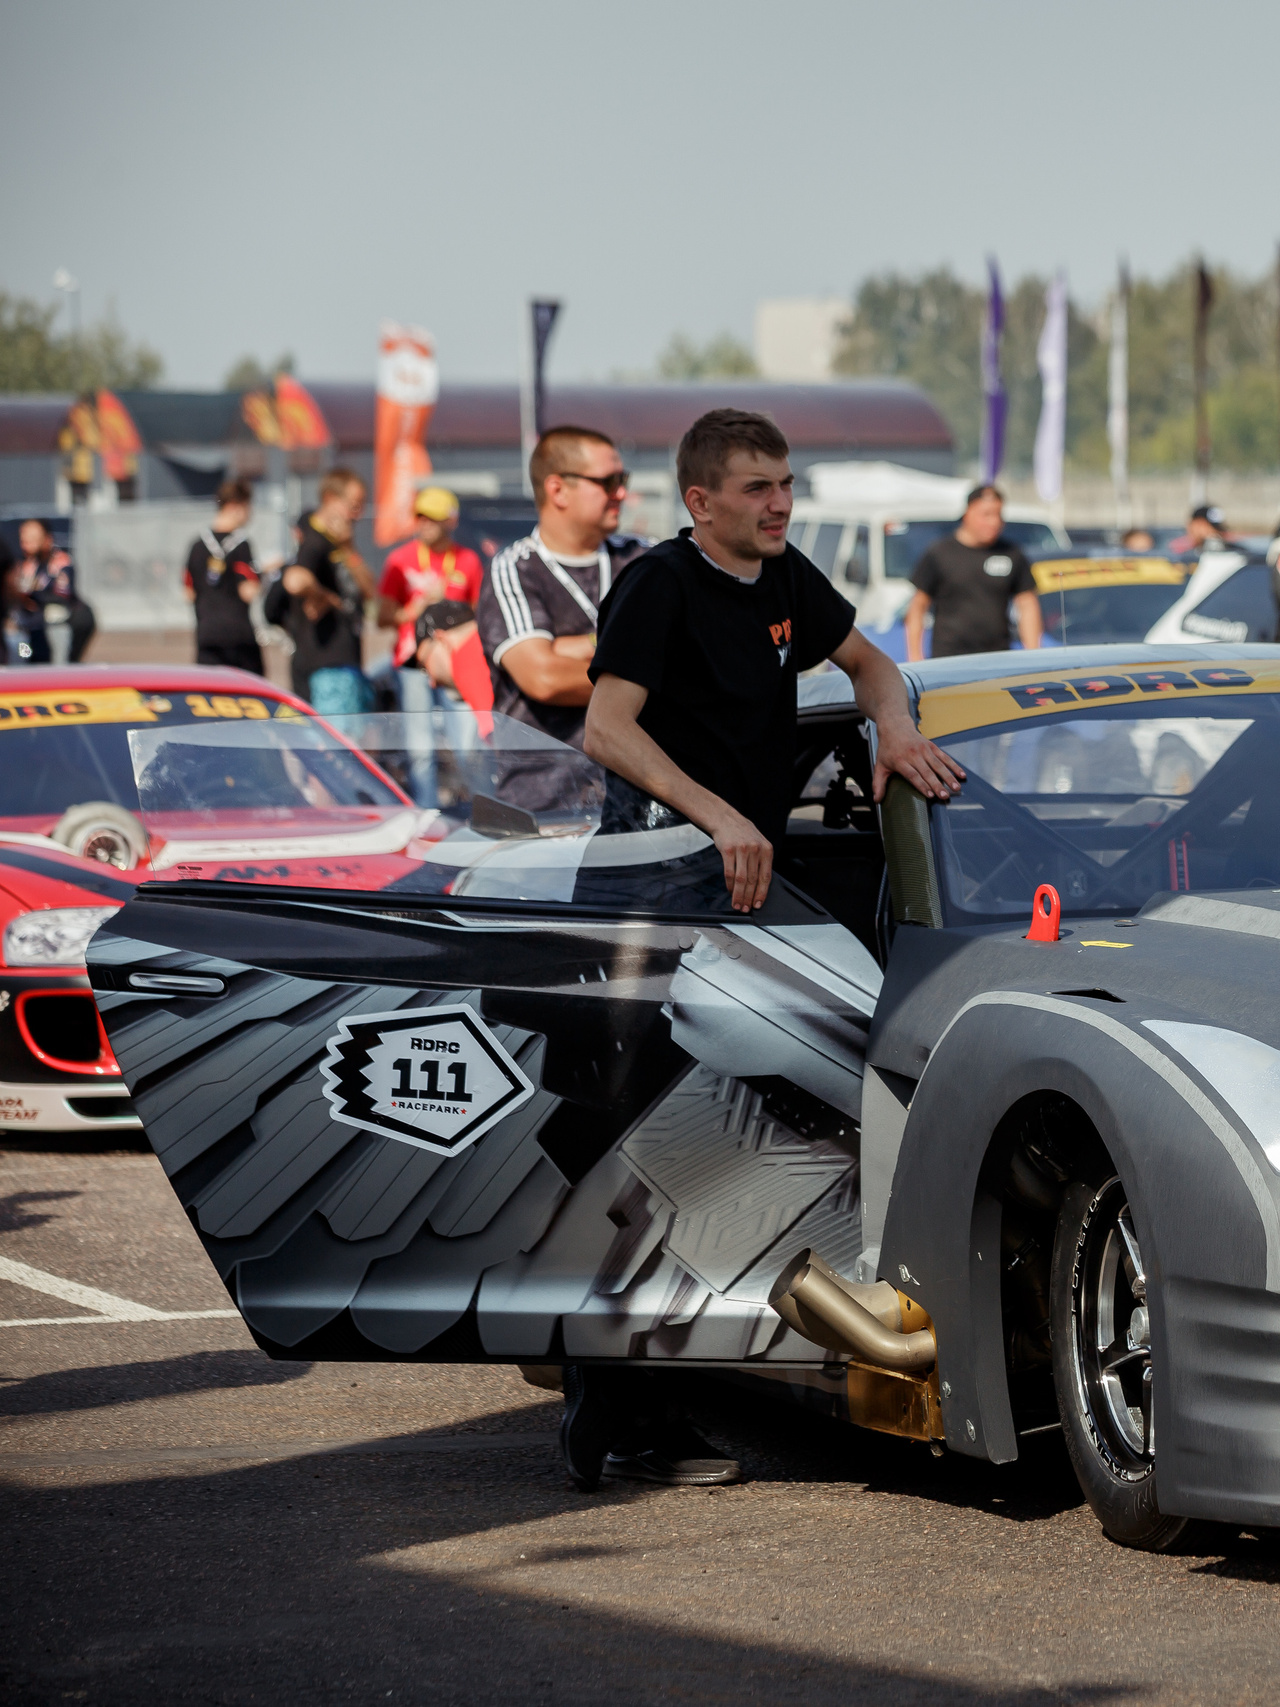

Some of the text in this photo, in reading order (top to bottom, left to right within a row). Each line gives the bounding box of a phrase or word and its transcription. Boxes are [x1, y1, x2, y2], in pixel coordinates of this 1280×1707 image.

[768, 618, 792, 645] PR
[1001, 668, 1256, 709] RDRC
[410, 1037, 461, 1054] RDRC
[391, 1058, 473, 1103] 111
[398, 1100, 460, 1115] RACEPARK
